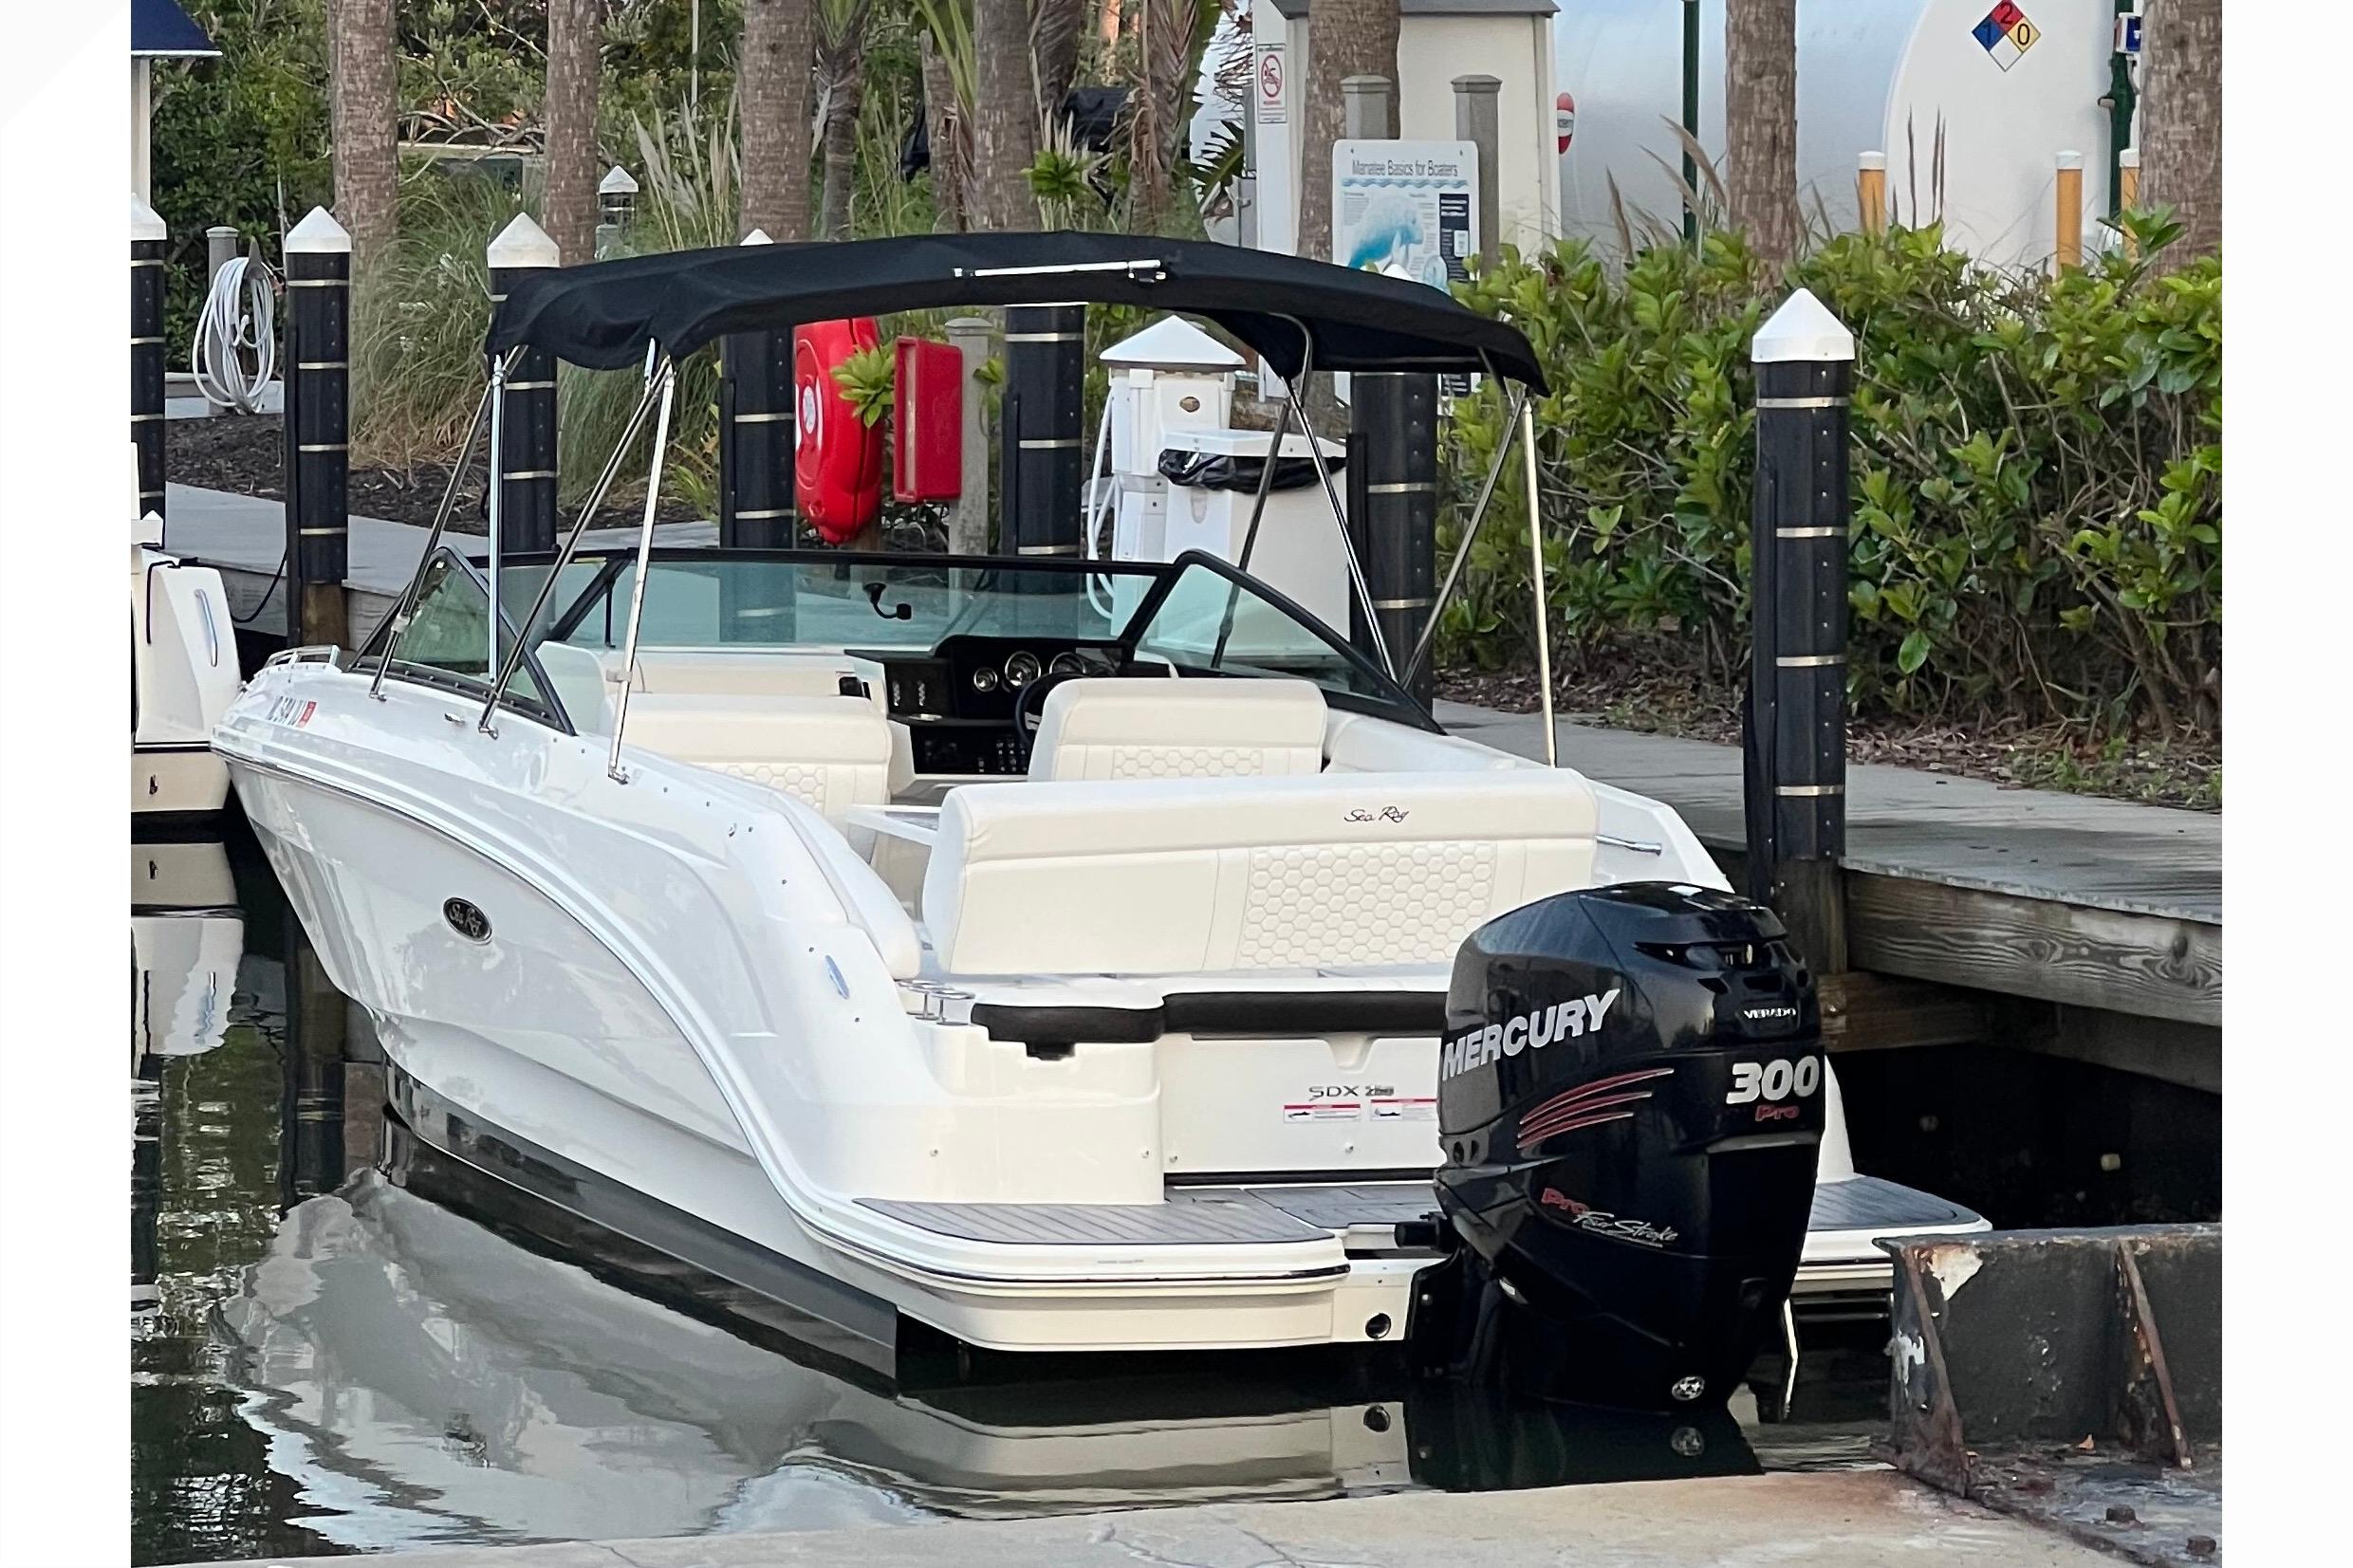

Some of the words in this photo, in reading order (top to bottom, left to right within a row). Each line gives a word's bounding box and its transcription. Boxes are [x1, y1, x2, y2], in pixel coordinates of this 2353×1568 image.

[2000, 2, 2013, 25] 2
[2017, 23, 2030, 46] 0
[1352, 159, 1386, 176] Manatee
[1388, 159, 1414, 176] Basics
[1416, 159, 1426, 176] for
[1428, 159, 1458, 177] Boaters
[1343, 809, 1376, 822] Sea
[1379, 805, 1410, 823] Ray
[1743, 1007, 1796, 1019] VERADO
[1442, 988, 1621, 1081] MERCURY
[1726, 1055, 1820, 1104] 300
[1308, 1085, 1360, 1100] SDX
[1755, 1104, 1800, 1121] Pro
[1541, 1188, 1590, 1214] Pro
